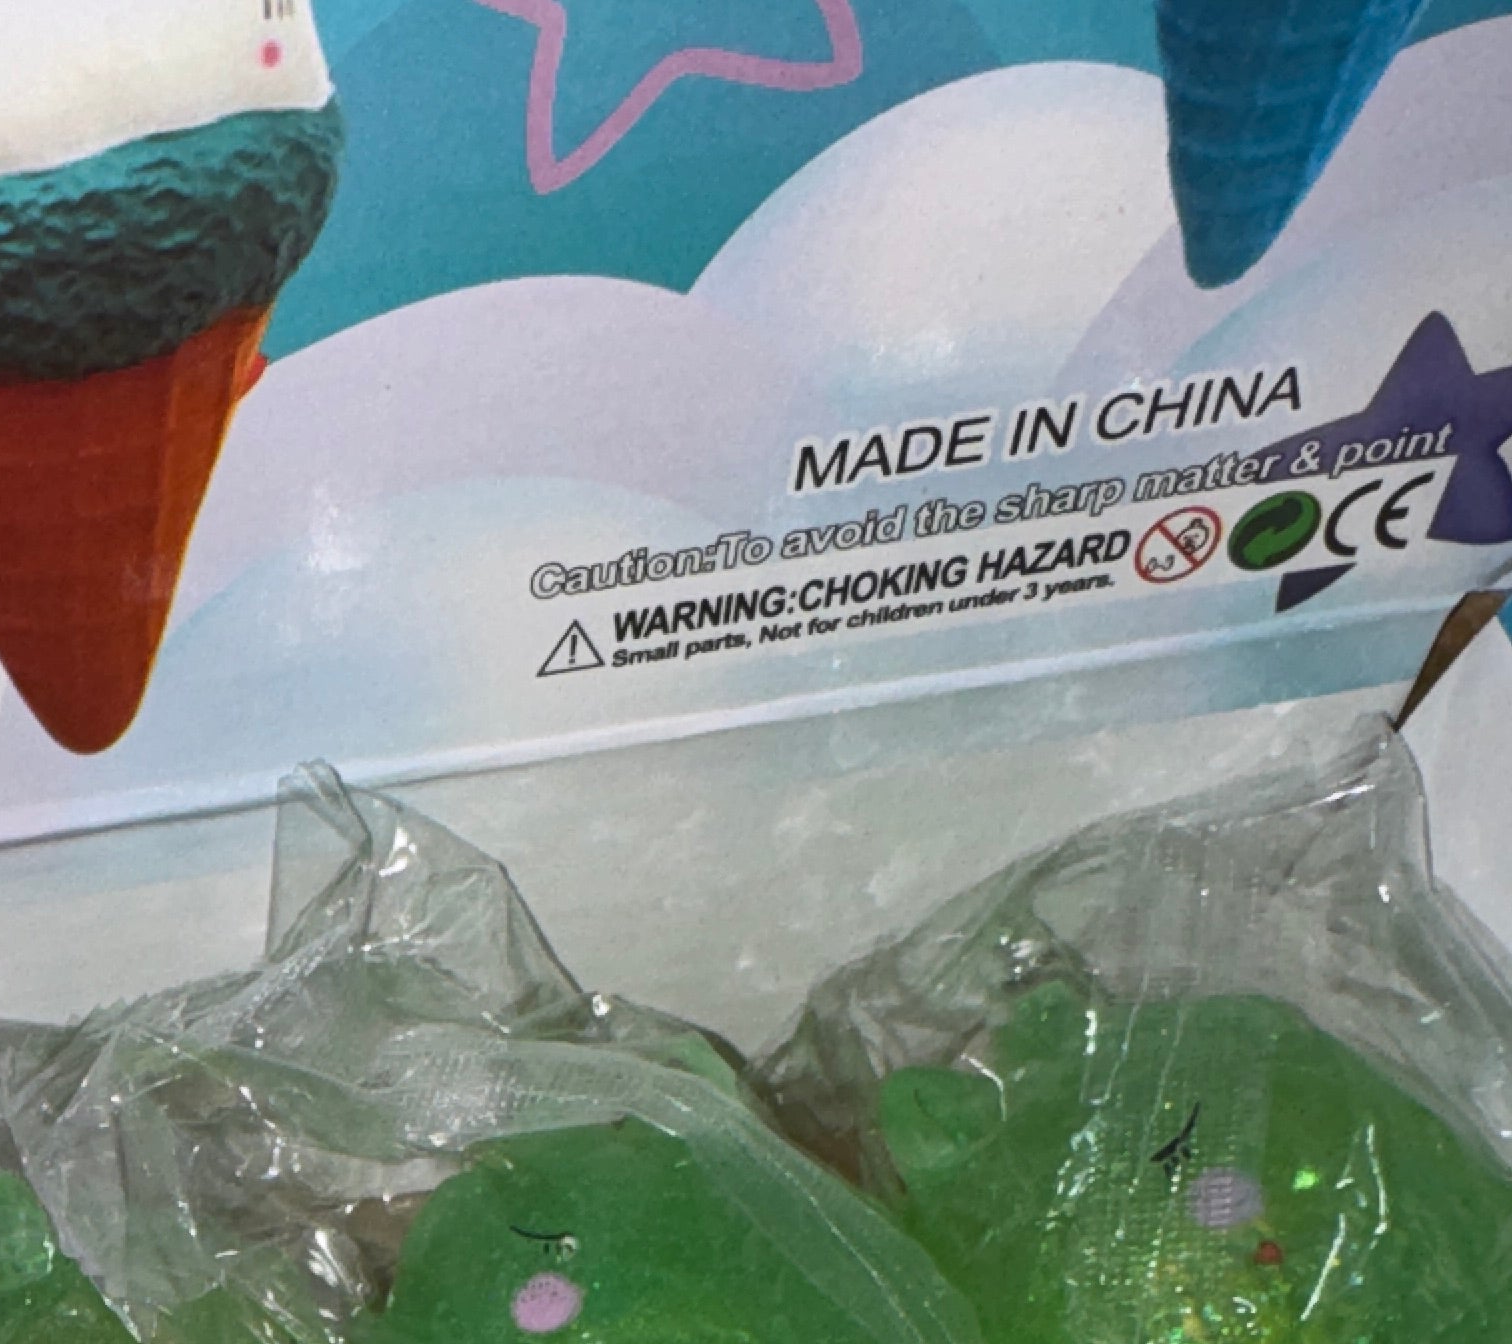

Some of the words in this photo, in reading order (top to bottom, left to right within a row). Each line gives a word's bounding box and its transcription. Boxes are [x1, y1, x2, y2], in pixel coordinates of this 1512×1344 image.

[793, 414, 993, 492] MADE
[1008, 400, 1079, 457] IN
[1096, 365, 1302, 441] CHINA
[779, 502, 909, 560] avoid
[914, 497, 987, 539] the
[994, 478, 1127, 524] sharp
[1132, 450, 1282, 504] matter
[1288, 439, 1321, 476] &
[1329, 420, 1455, 479] point
[976, 528, 1132, 585] HAZARD
[611, 640, 679, 668] Small
[683, 630, 753, 660] parts,
[757, 623, 802, 645] Not
[805, 614, 842, 637] for
[845, 597, 944, 630] children
[948, 585, 1021, 614] under
[1023, 582, 1039, 601] 3
[1039, 572, 1116, 602] years.
